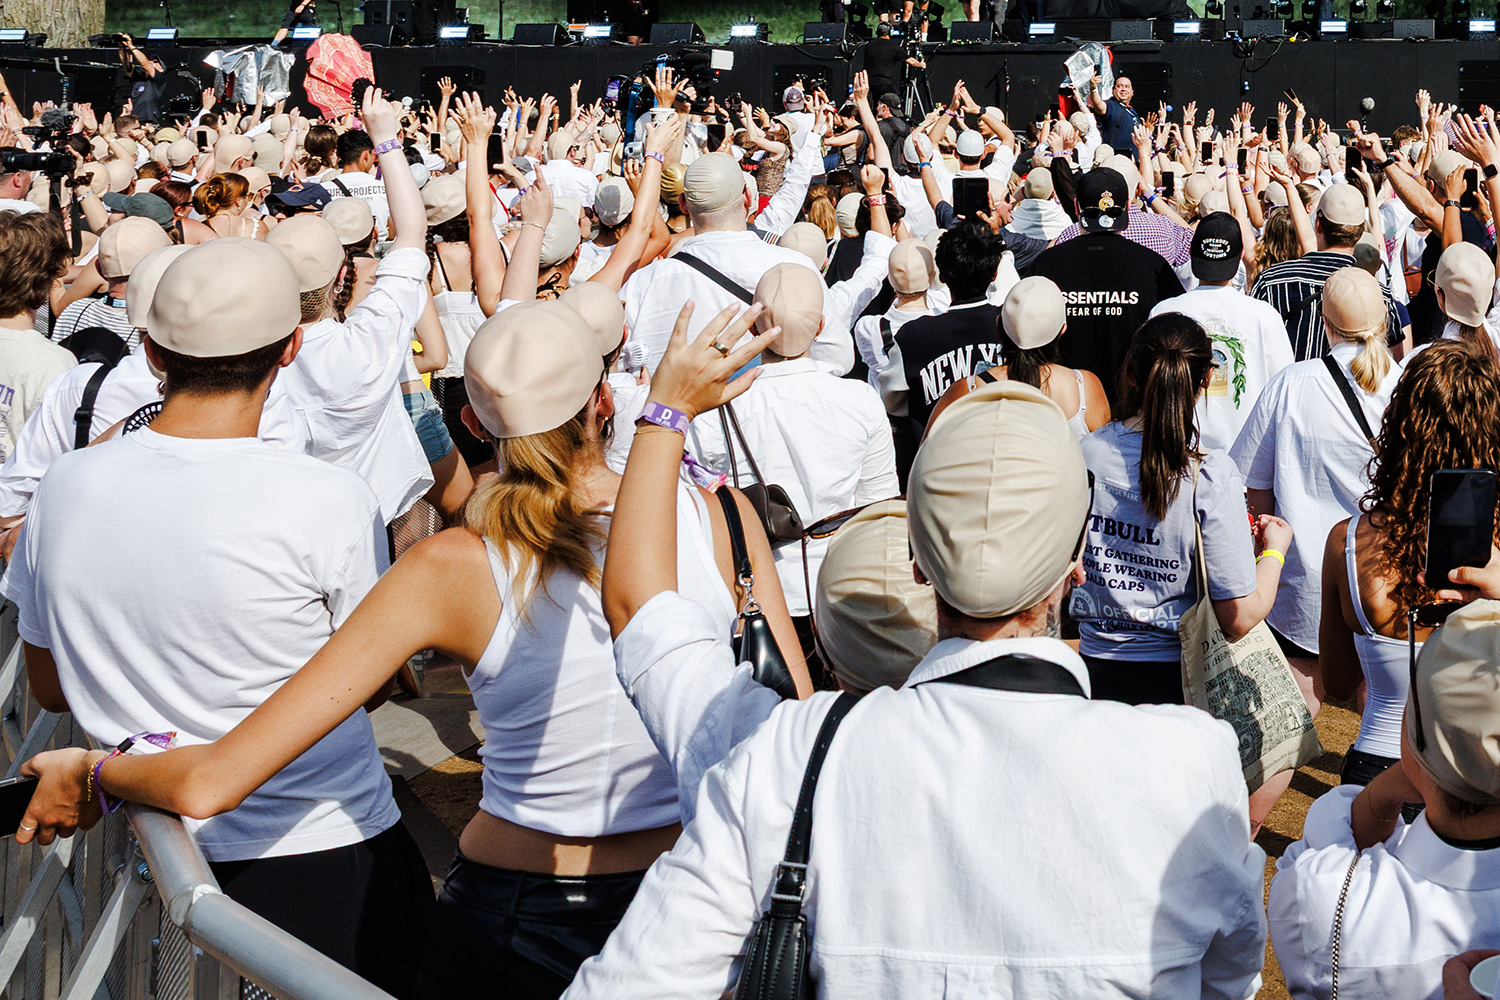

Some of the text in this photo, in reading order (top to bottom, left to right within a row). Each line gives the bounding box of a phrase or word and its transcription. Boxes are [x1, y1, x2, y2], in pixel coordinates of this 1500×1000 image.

[348, 185, 386, 196] PROJECTS
[1061, 291, 1139, 305] SSENTIALS
[1066, 306, 1122, 316] FEAR OF GOD
[1206, 323, 1247, 346] BLANCA
[920, 344, 973, 405] NEW
[661, 408, 673, 420] D
[1123, 491, 1139, 502] PARK
[1089, 514, 1160, 546] TBULL
[1084, 543, 1180, 569] EST GATHERING
[1082, 556, 1178, 583] EOPLE WEARING
[1108, 579, 1145, 592] CAPS
[1102, 604, 1179, 622] OFFICIAL
